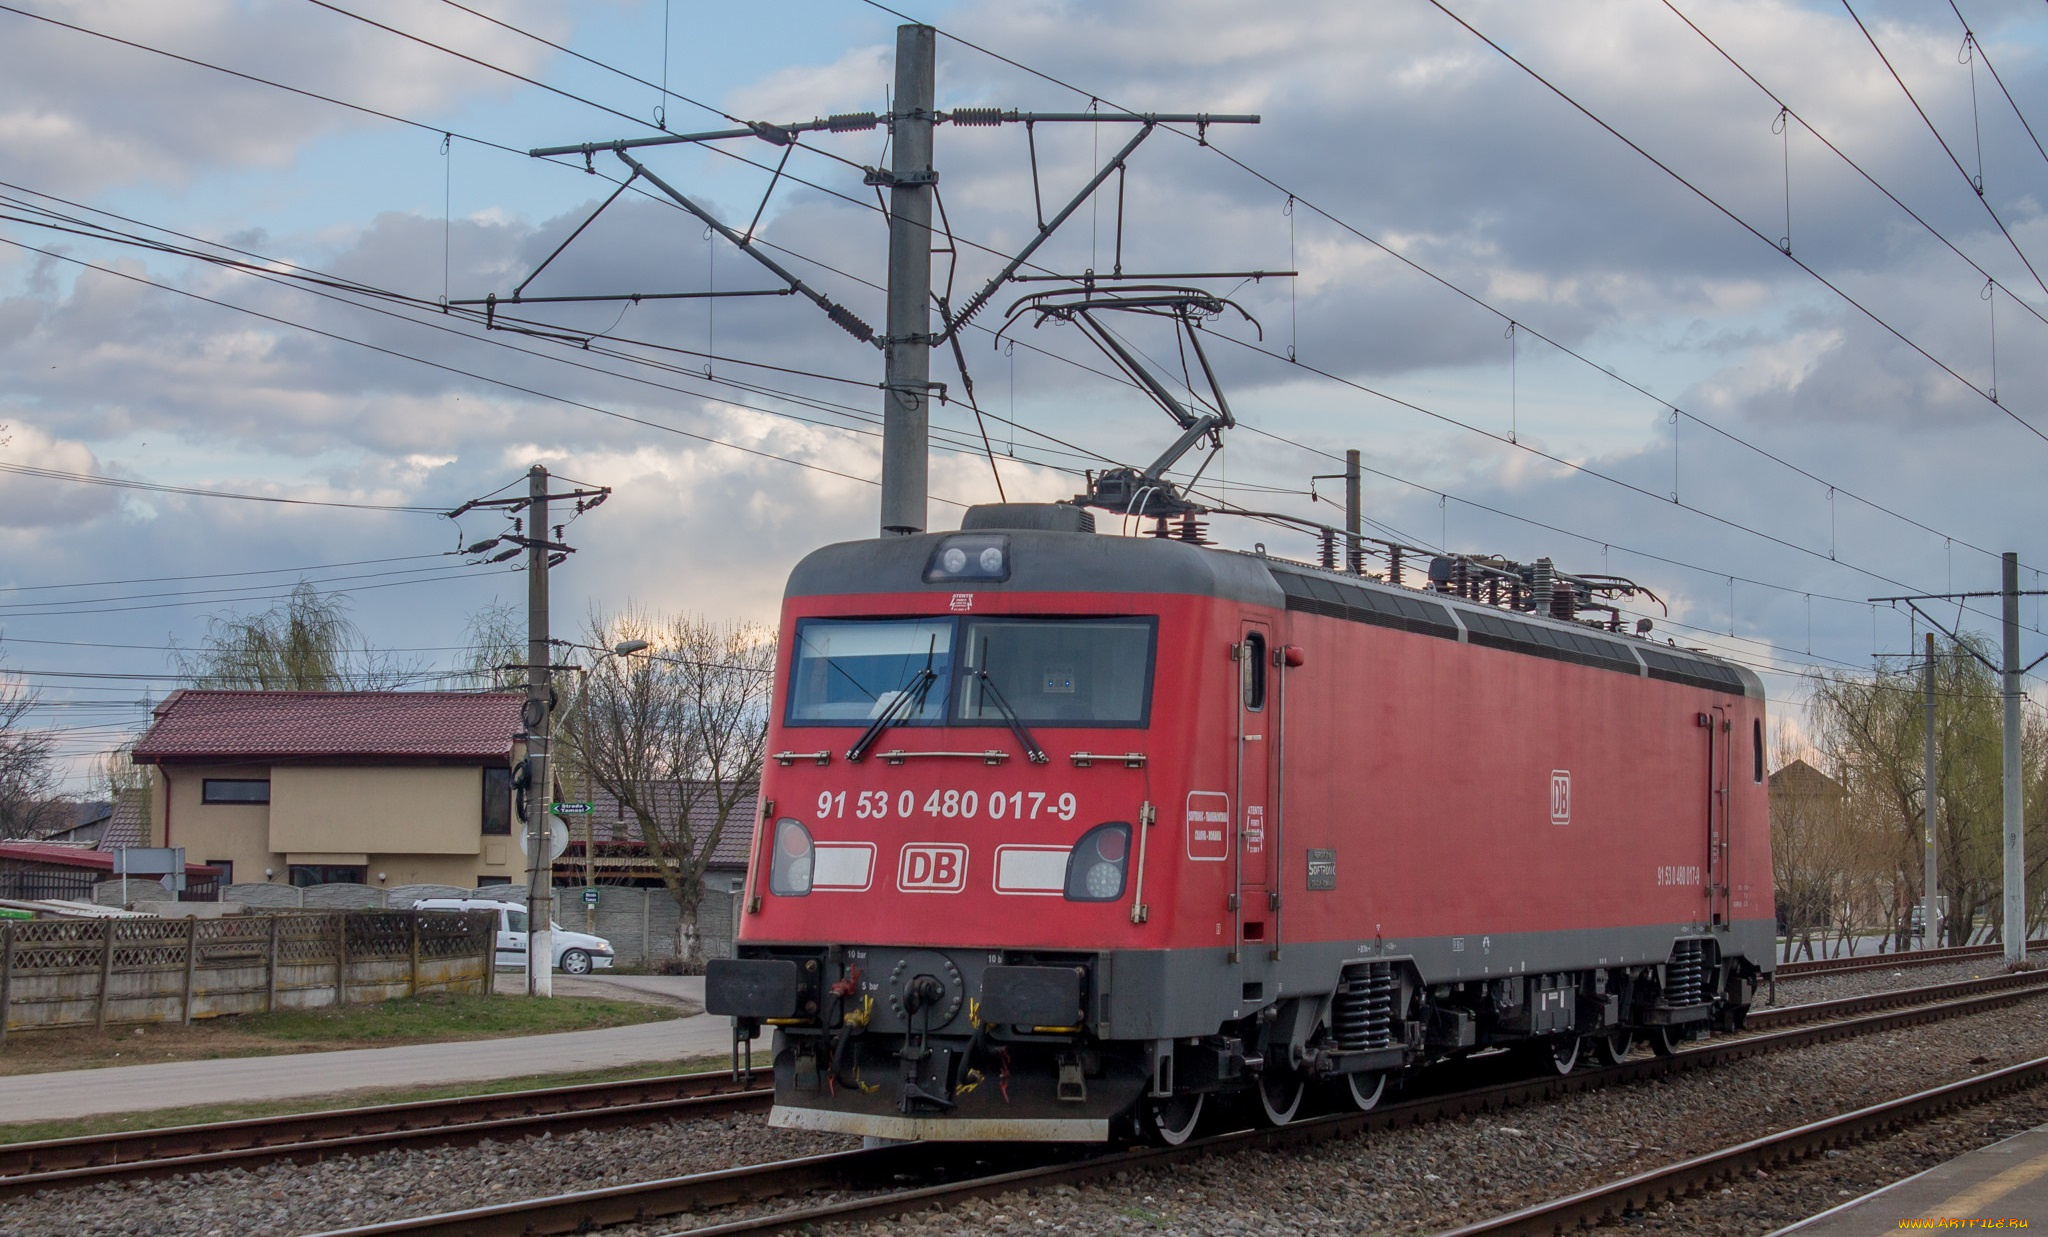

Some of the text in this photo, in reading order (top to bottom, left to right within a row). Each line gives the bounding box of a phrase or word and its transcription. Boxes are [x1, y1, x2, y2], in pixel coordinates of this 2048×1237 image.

[816, 789, 1077, 821] 91 53 0 480 017-9
[1553, 777, 1568, 817] DB
[904, 849, 959, 886] DB
[848, 950, 867, 959] 10 bar
[988, 954, 997, 963] 10
[862, 981, 879, 991] 5 bar
